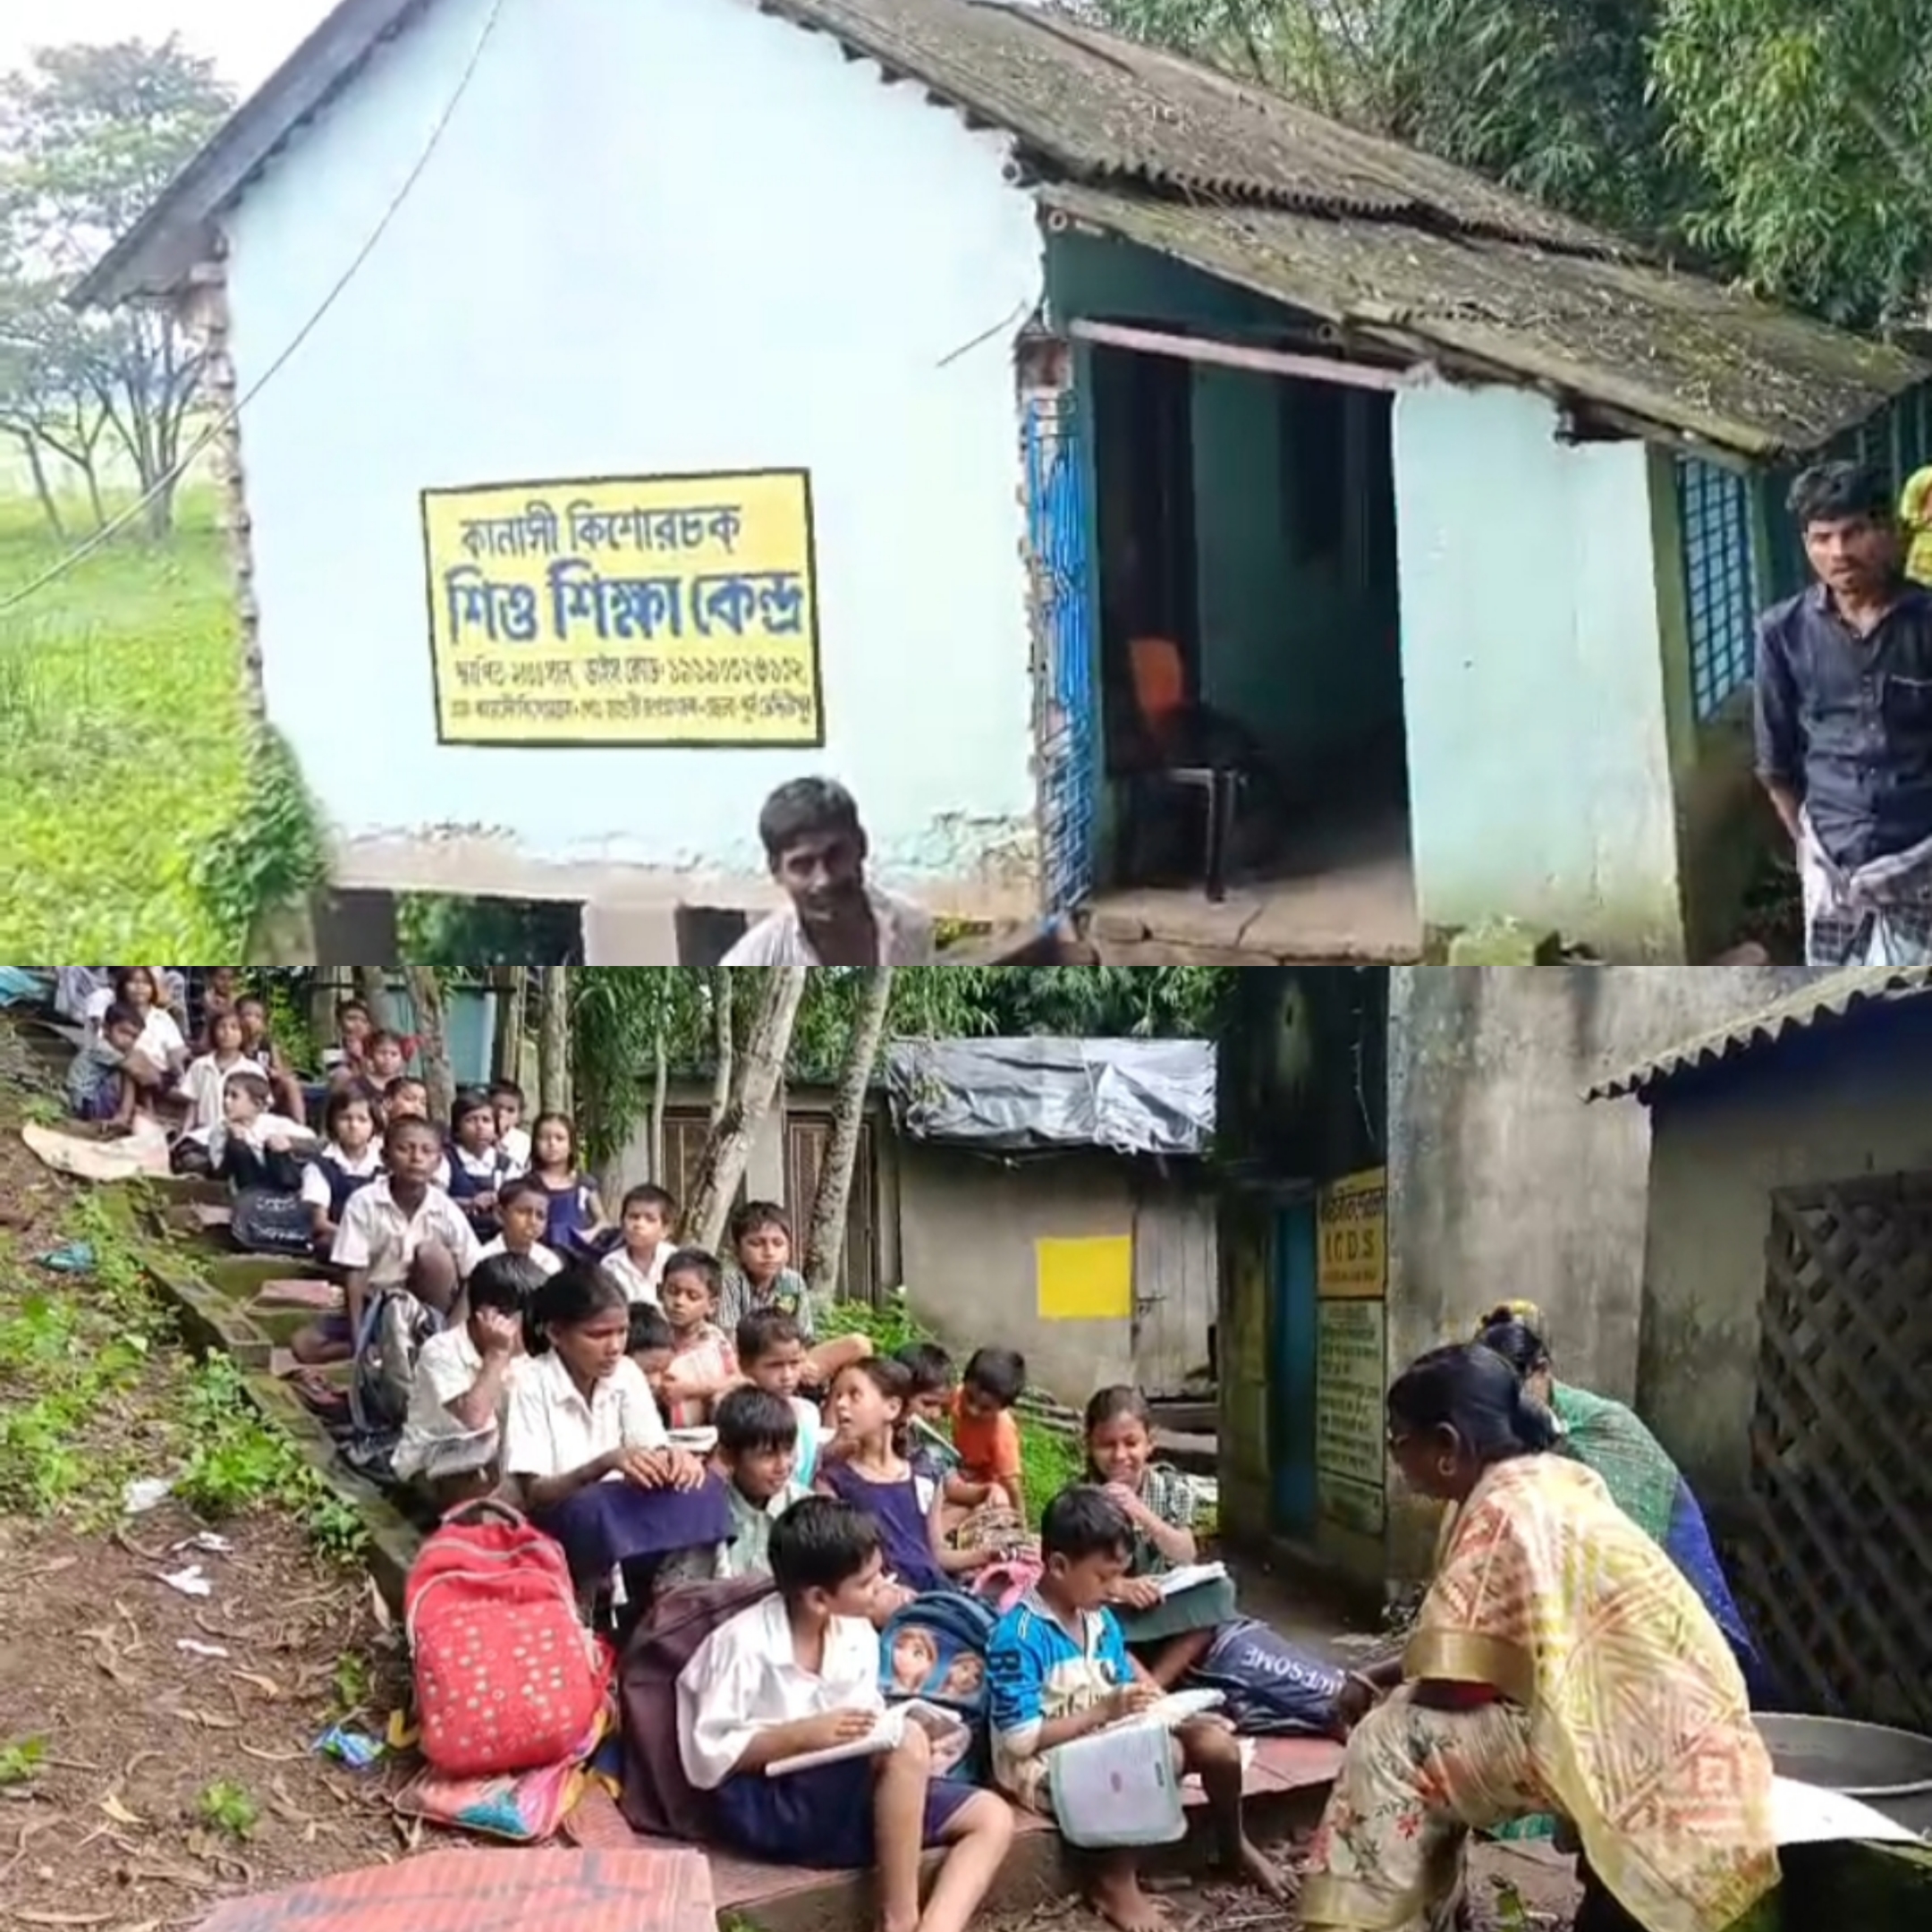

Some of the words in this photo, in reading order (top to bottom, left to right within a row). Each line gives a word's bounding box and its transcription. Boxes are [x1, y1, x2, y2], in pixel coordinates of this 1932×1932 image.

[445, 564, 537, 645] শিশু
[547, 558, 682, 640] শিক্ষা
[692, 572, 803, 636] কেন্দ্র
